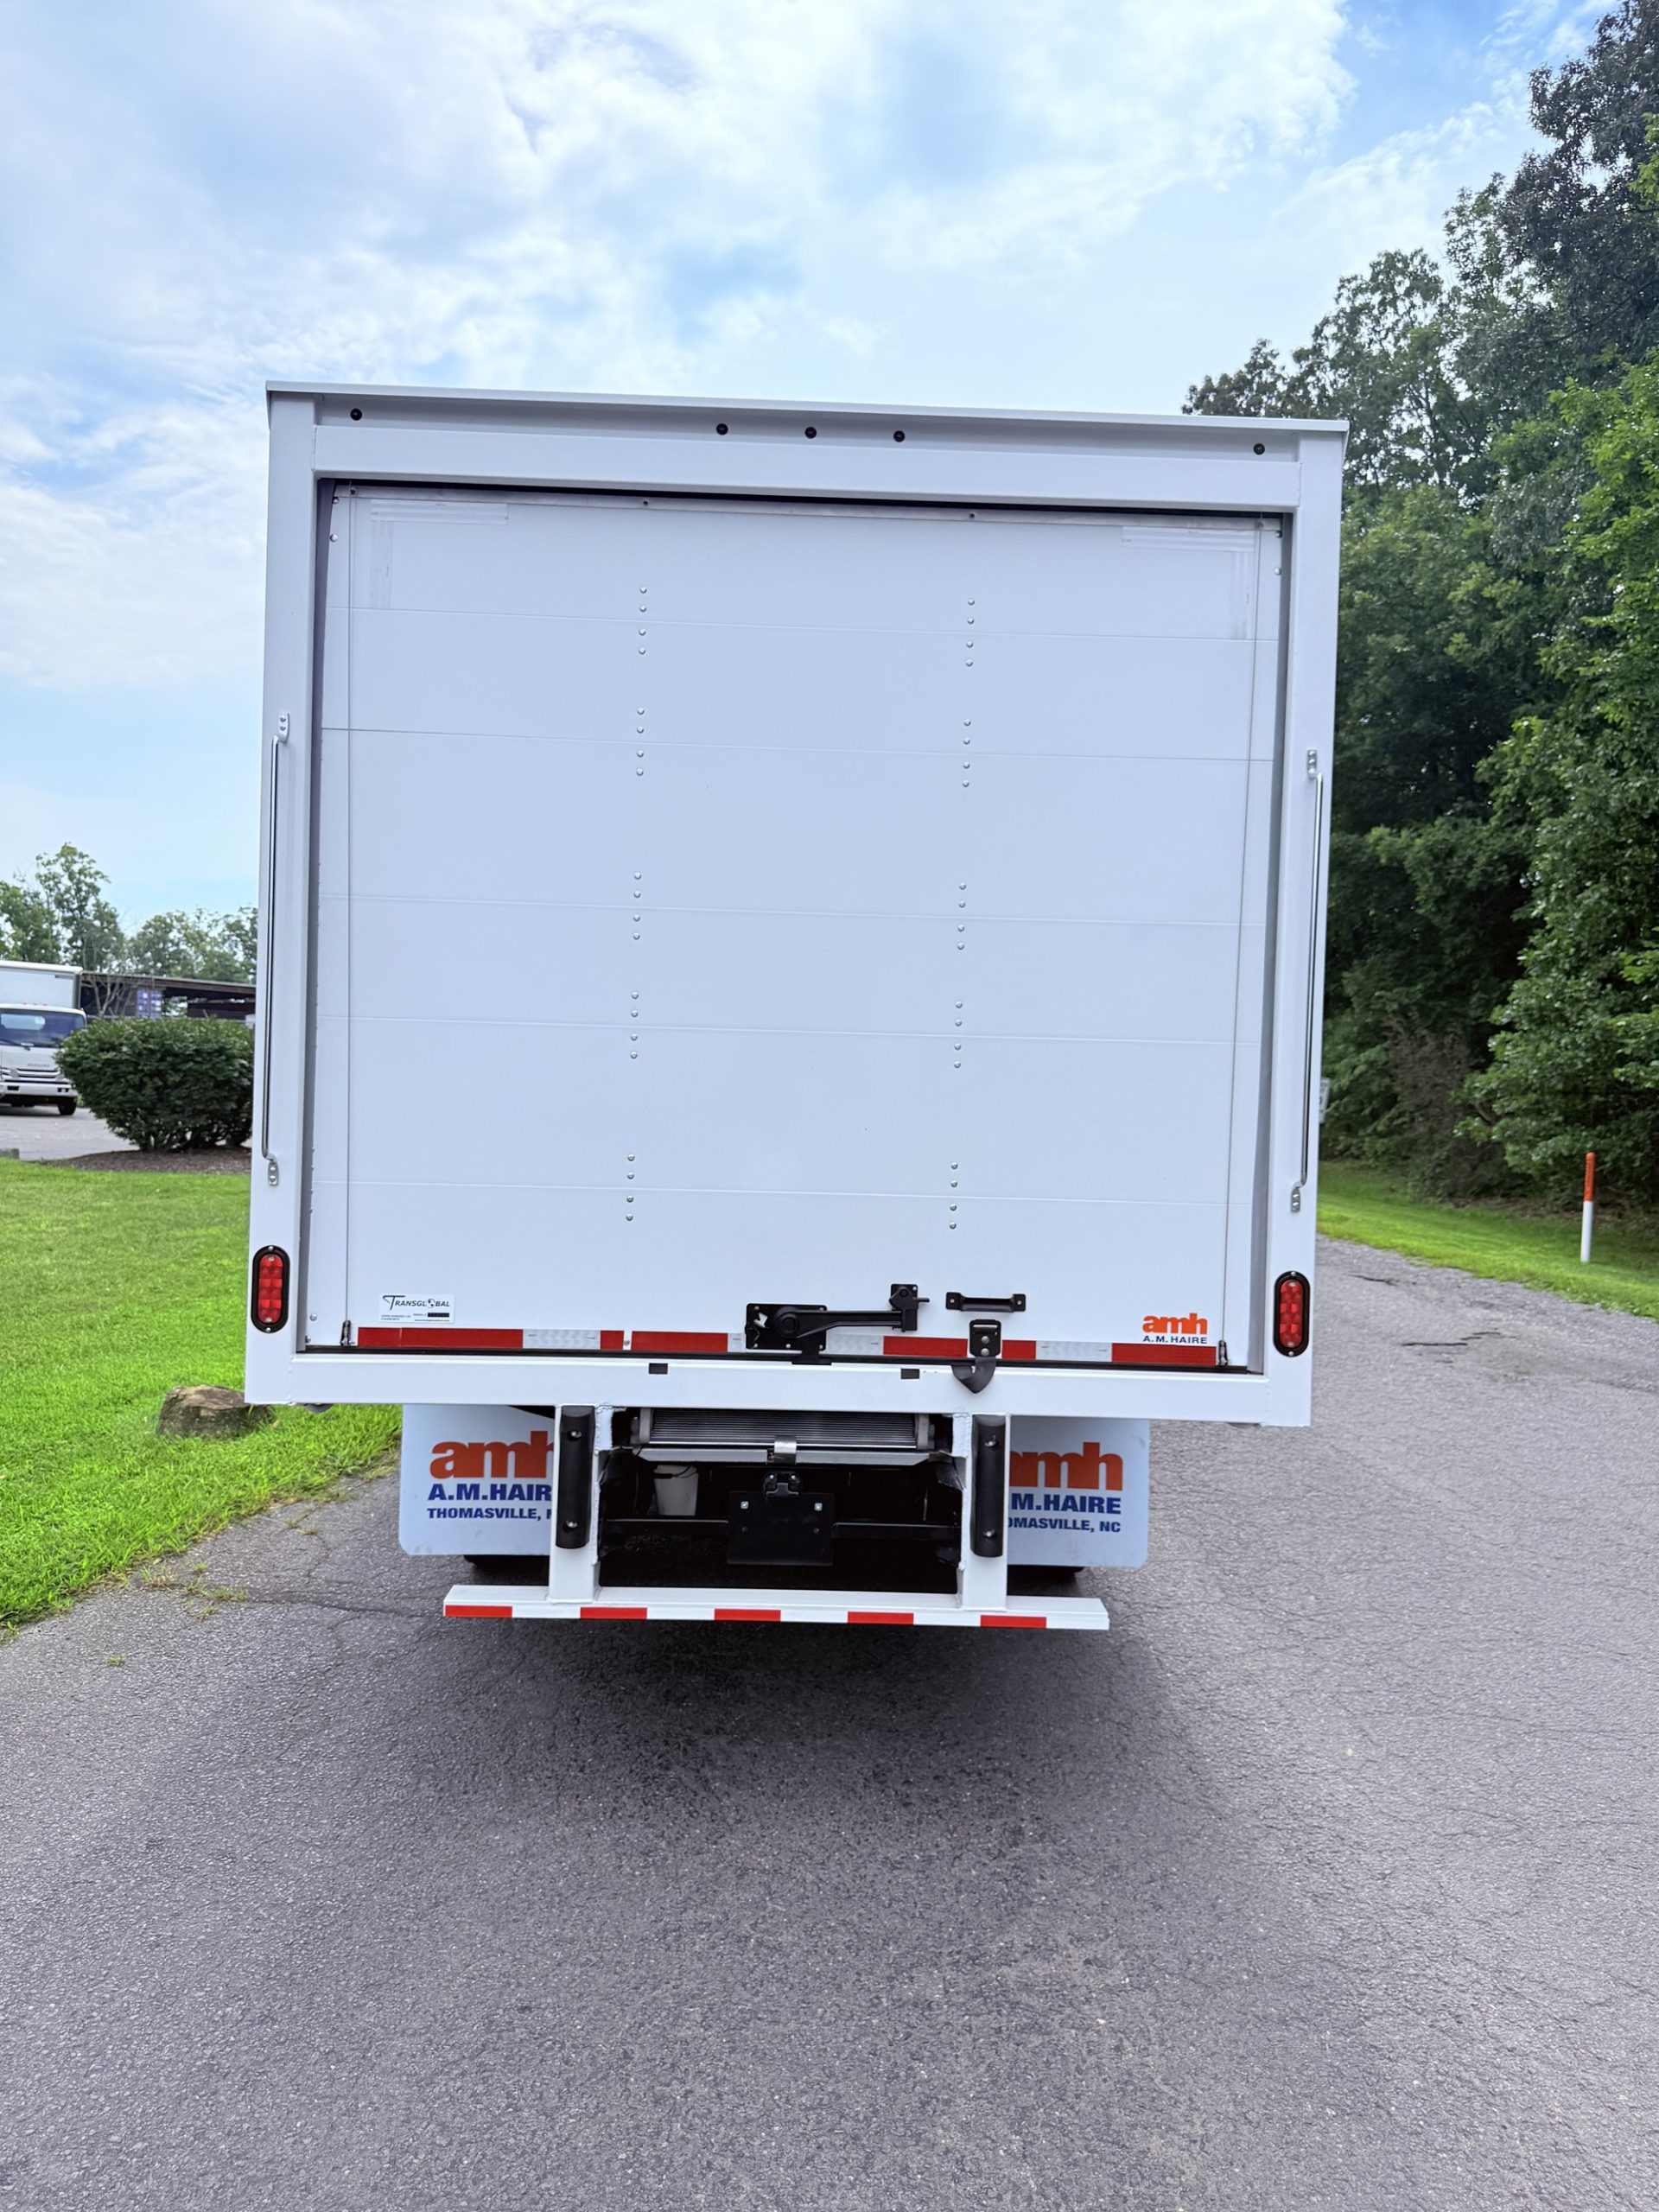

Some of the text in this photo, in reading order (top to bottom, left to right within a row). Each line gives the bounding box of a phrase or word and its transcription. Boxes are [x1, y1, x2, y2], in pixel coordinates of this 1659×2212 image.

[1142, 1313, 1208, 1335] amh
[428, 1483, 552, 1502] A.M.HAIR
[427, 1507, 542, 1521] THOMASVILLE,
[1099, 1521, 1122, 1533] NC
